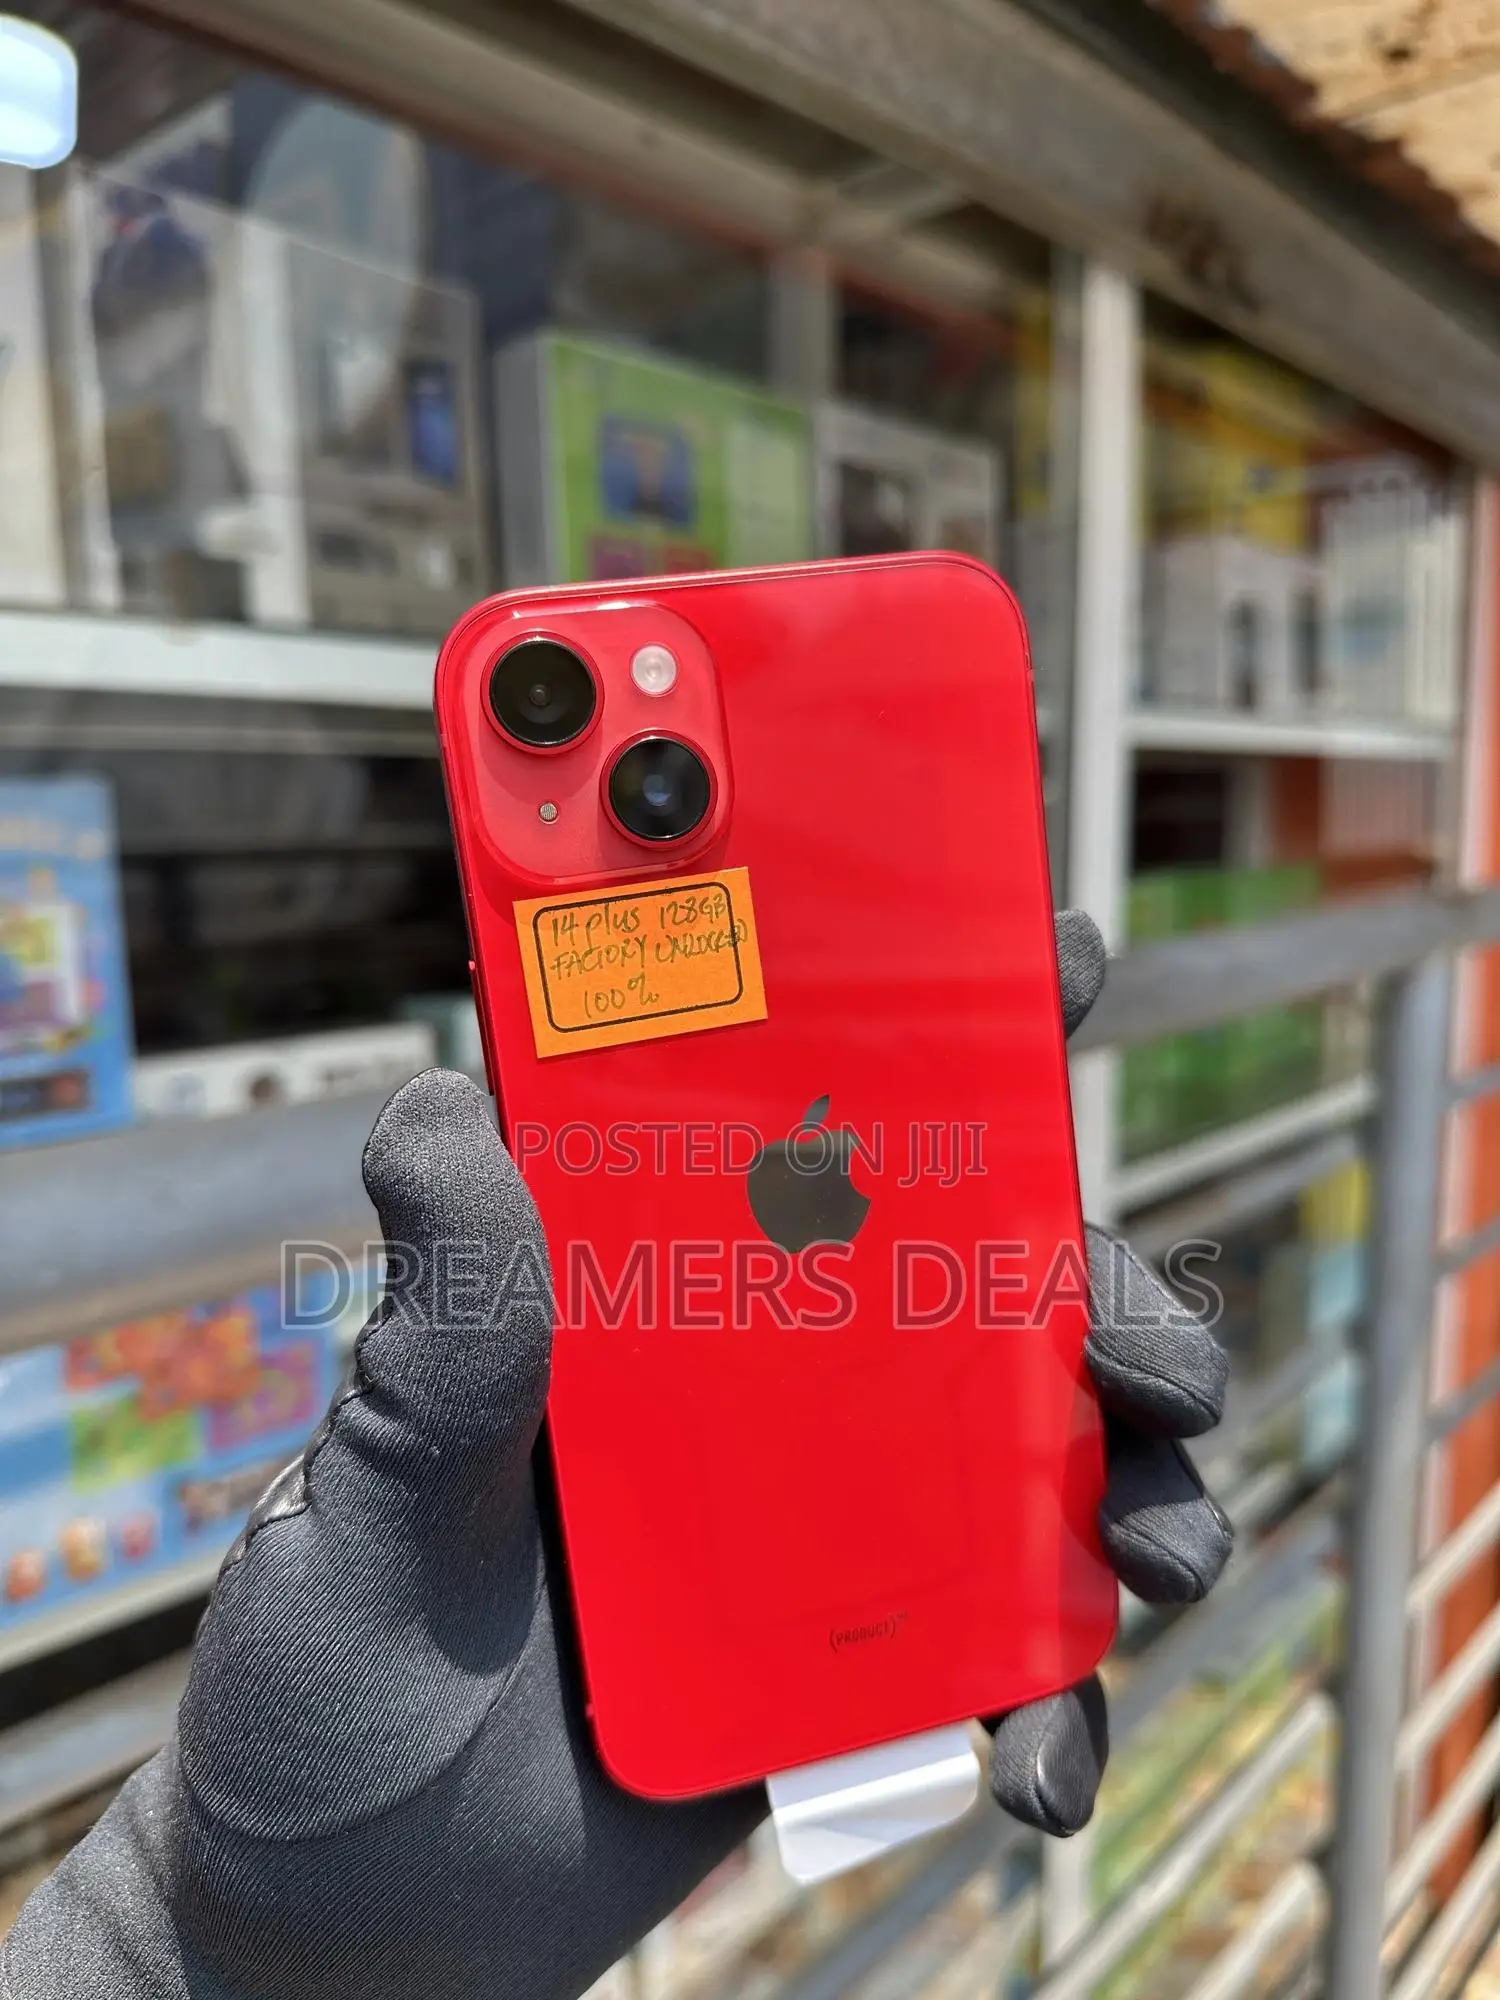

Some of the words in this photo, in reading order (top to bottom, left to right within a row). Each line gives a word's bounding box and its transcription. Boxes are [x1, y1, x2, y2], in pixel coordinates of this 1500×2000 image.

[551, 912, 579, 947] 14
[660, 893, 727, 930] 128GB
[551, 934, 648, 981] FACTORY
[583, 971, 660, 1018] 100%
